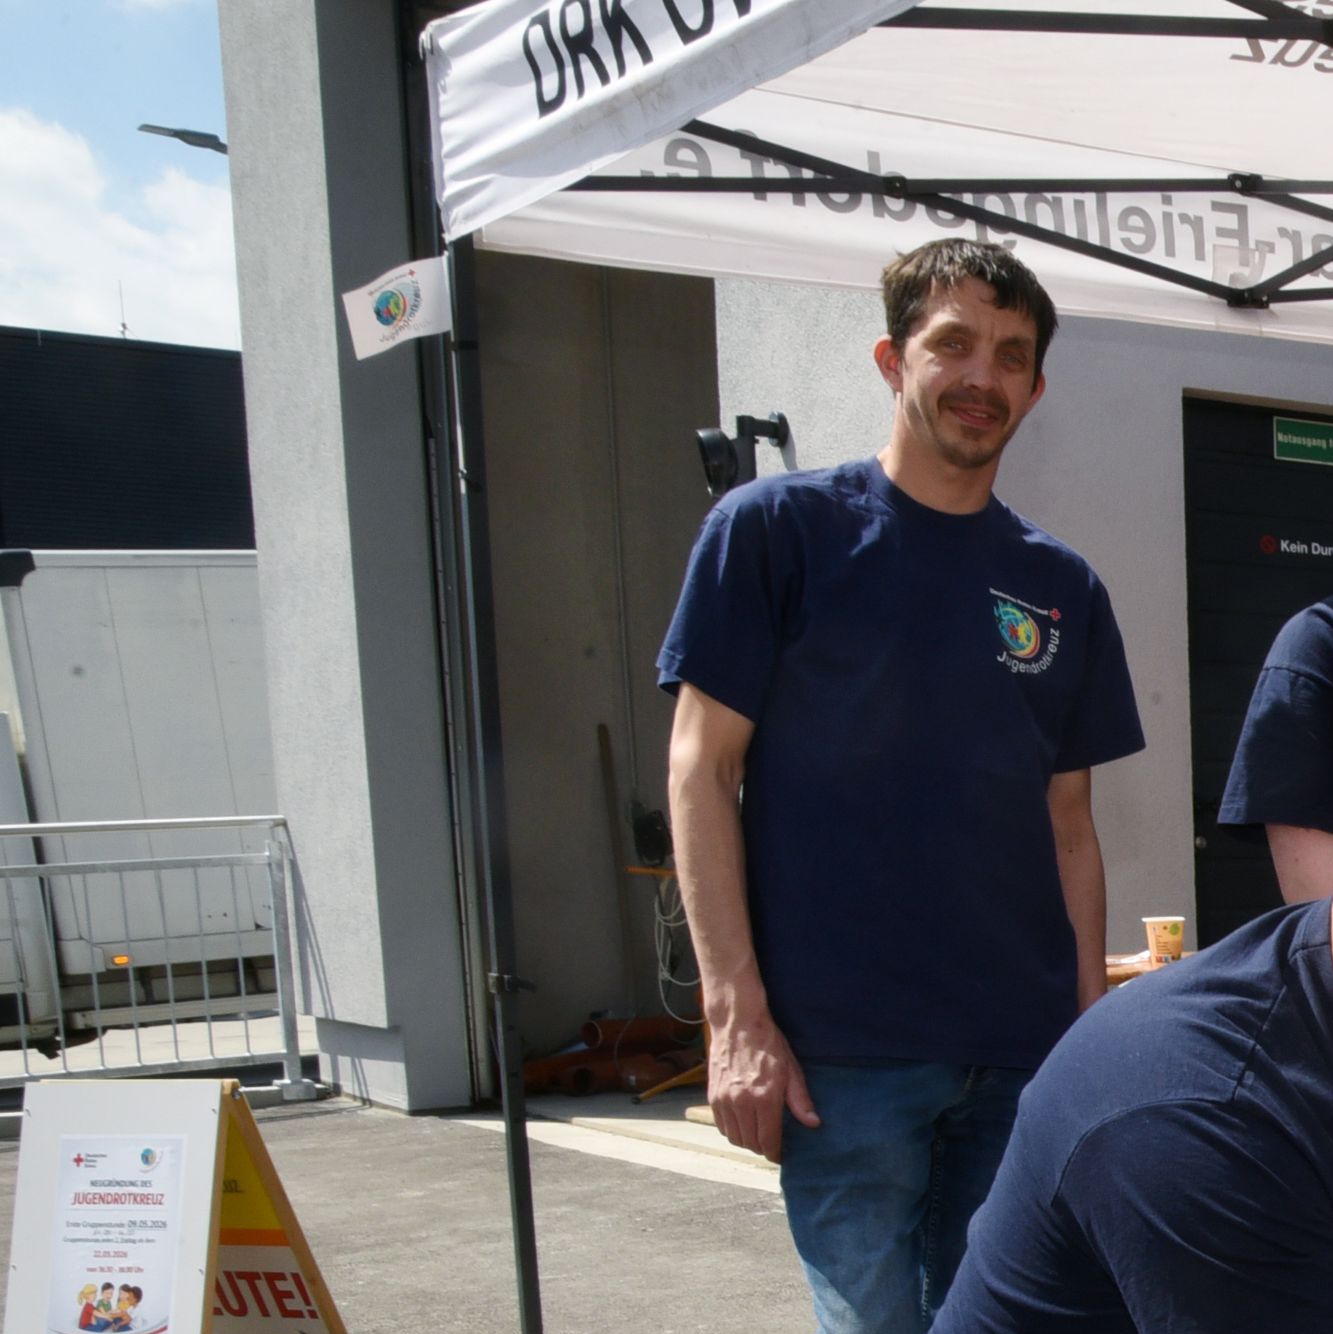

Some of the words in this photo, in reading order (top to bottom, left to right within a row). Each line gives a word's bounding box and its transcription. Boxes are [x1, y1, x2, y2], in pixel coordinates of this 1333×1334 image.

[522, 0, 653, 119] DRK
[1277, 432, 1327, 450] Notausgang
[1280, 539, 1308, 555] Kein
[997, 627, 1061, 674] Jugendrotkreuz
[71, 1192, 165, 1206] JUGENDROTKREUZ
